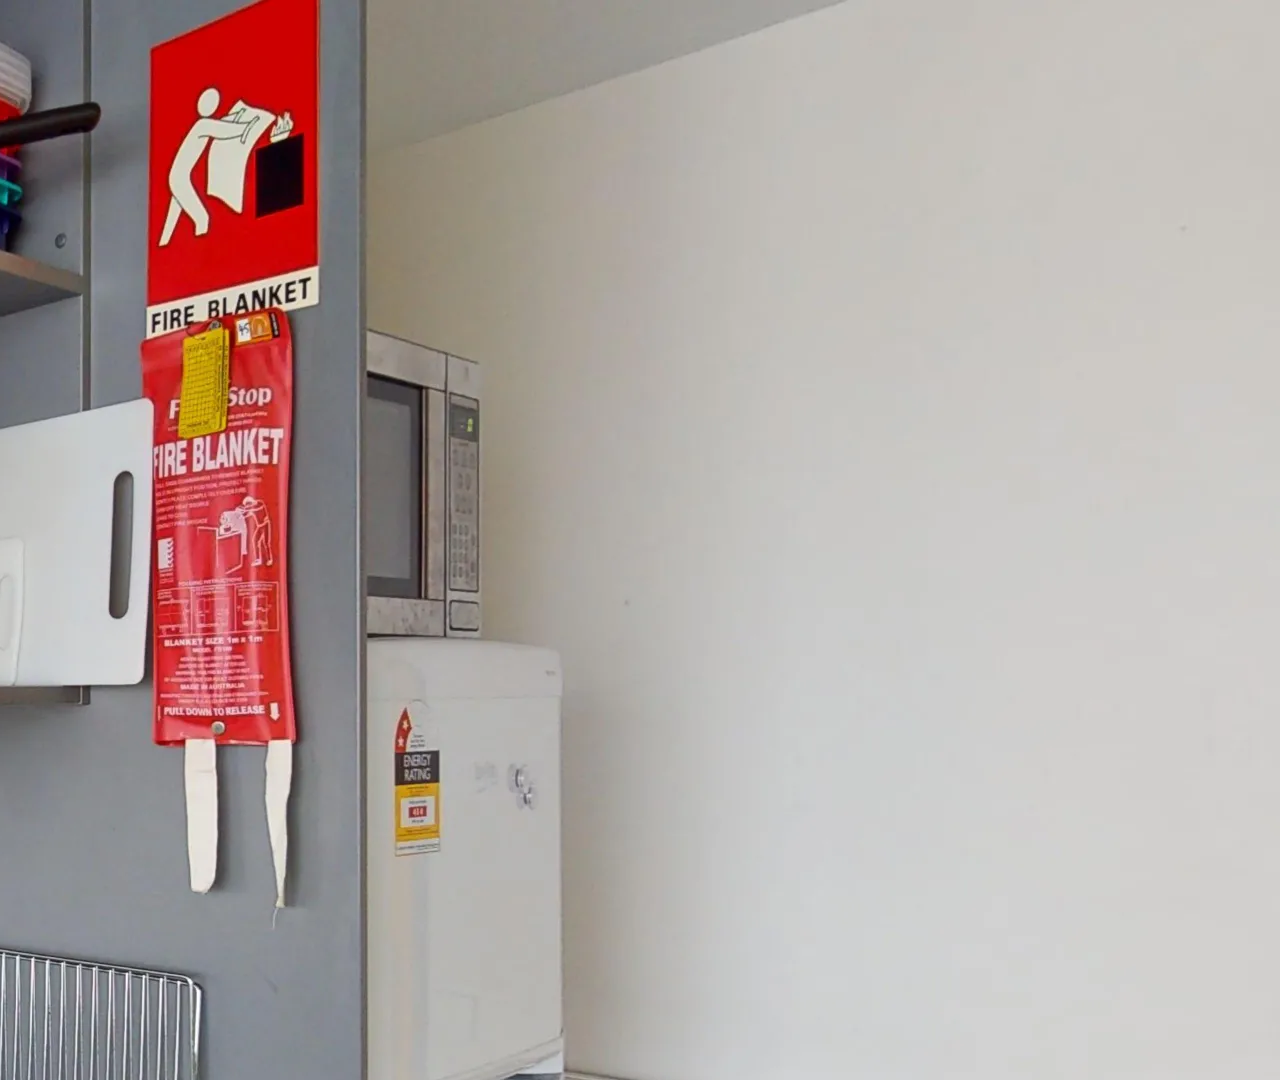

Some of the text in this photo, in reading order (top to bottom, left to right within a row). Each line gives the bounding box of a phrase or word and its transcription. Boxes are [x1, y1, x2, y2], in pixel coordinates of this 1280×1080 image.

[151, 277, 312, 333] FIRE BLANKET
[228, 386, 272, 407] Stop
[154, 440, 187, 479] FIRE
[192, 428, 283, 473] BLANKET
[164, 638, 203, 647] BLANKET
[205, 637, 224, 645] SIZE
[163, 705, 265, 716] PULL DOWN TO RELEASE
[403, 754, 431, 767] ENERGY
[404, 767, 431, 780] RATING
